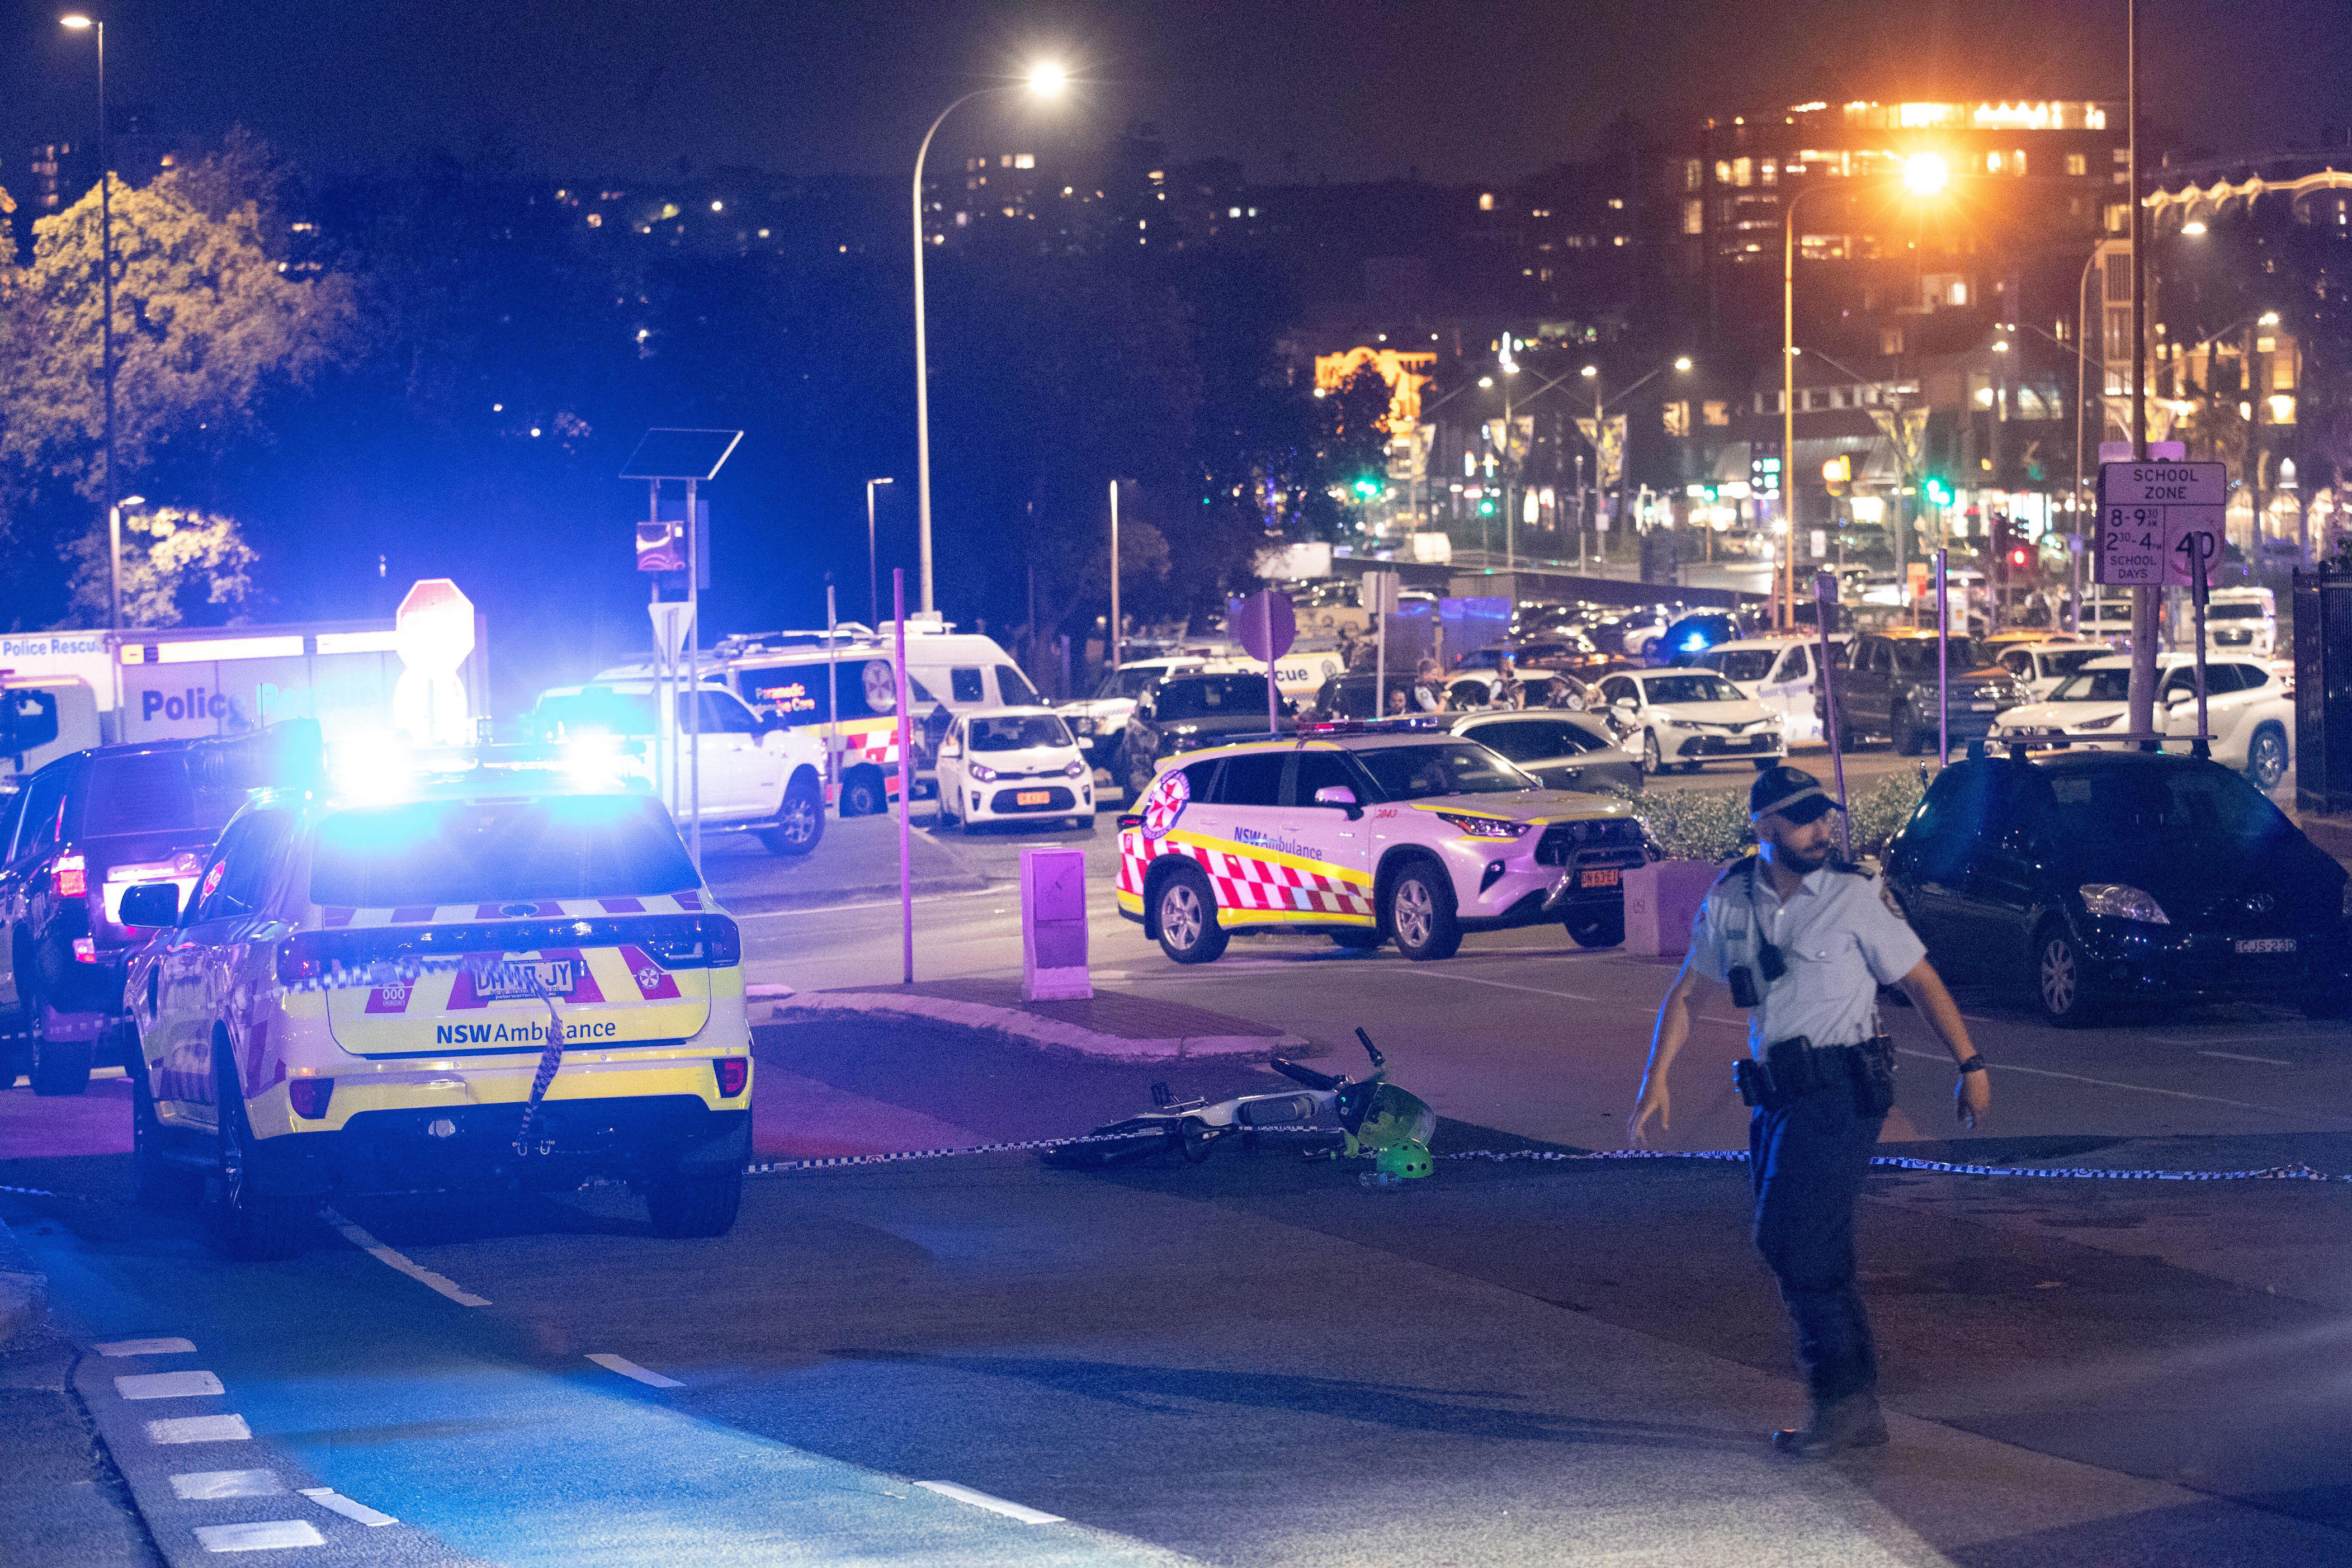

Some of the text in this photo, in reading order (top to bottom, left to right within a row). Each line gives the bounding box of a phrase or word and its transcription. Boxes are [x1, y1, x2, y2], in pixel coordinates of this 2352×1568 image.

[2133, 469, 2198, 482] SCHOOL
[2144, 487, 2186, 499] ZONE
[2175, 532, 2214, 559] 40
[2110, 556, 2157, 566] SCHOOL
[2118, 568, 2148, 578] DAYS
[3, 637, 101, 657] Police Rescu
[1234, 826, 1322, 861] NSW Ambulance
[382, 989, 405, 1000] 000
[437, 1024, 491, 1044] NSW
[494, 1021, 616, 1042] Ambuance
